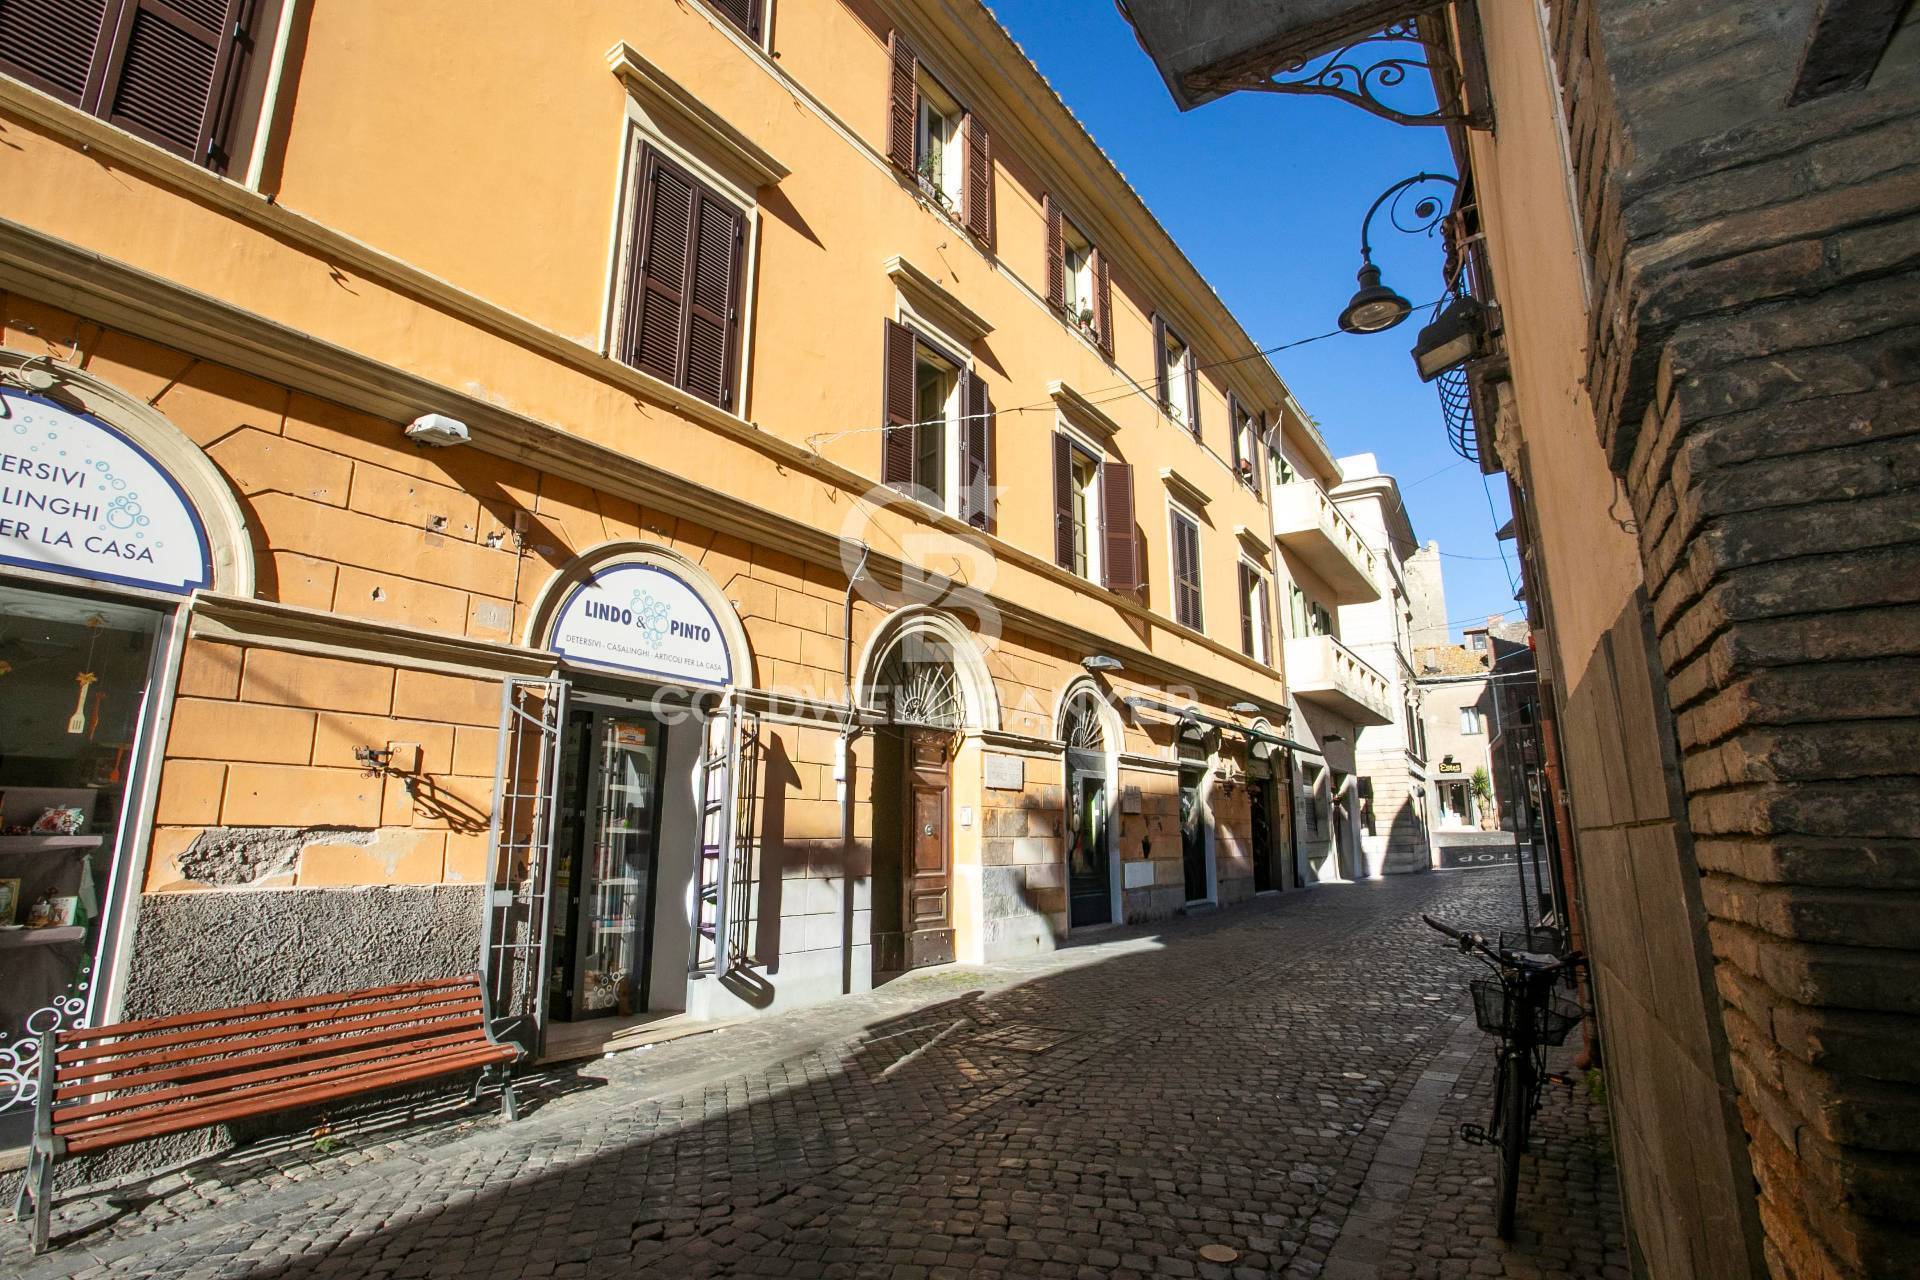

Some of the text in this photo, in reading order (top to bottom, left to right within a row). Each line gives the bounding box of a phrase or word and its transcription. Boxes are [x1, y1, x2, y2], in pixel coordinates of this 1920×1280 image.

[0, 453, 85, 488] ERSIVI
[42, 527, 73, 548] LA
[85, 536, 154, 563] CASA
[585, 600, 710, 643] LINDO & PINTO
[566, 634, 601, 648] DETERSIVI
[607, 642, 650, 658] CASALINGHI
[655, 653, 683, 664] ARTICOLI
[685, 658, 695, 666] PER
[696, 660, 704, 668] LA
[706, 662, 722, 671] CASA
